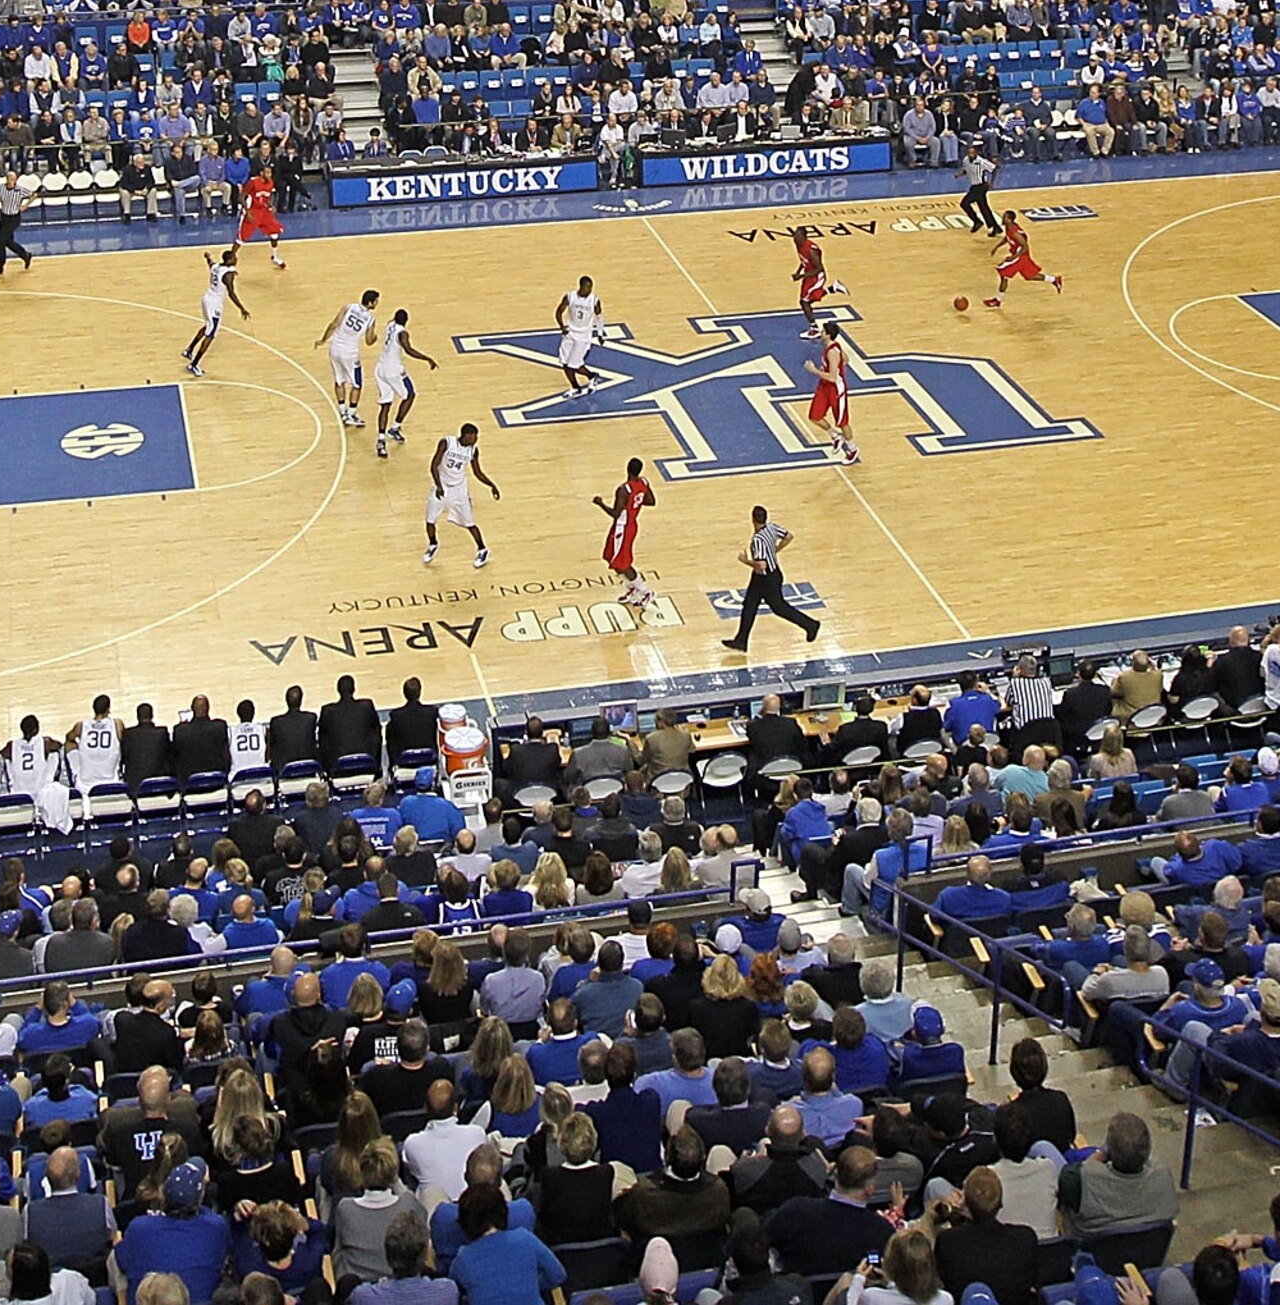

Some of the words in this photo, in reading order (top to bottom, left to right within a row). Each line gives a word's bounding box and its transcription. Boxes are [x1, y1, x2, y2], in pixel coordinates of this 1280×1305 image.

[680, 146, 850, 182] WILDCATS
[366, 165, 562, 202] KENTUCKY
[771, 207, 869, 222] KENTUCKY
[346, 314, 365, 333] 55
[447, 458, 463, 471] 34
[328, 590, 479, 615] KENTUCKY
[500, 595, 686, 643] RUPP
[249, 615, 485, 667] ARENA
[87, 730, 111, 749] 30
[236, 733, 260, 751] 20
[23, 752, 34, 771] 2
